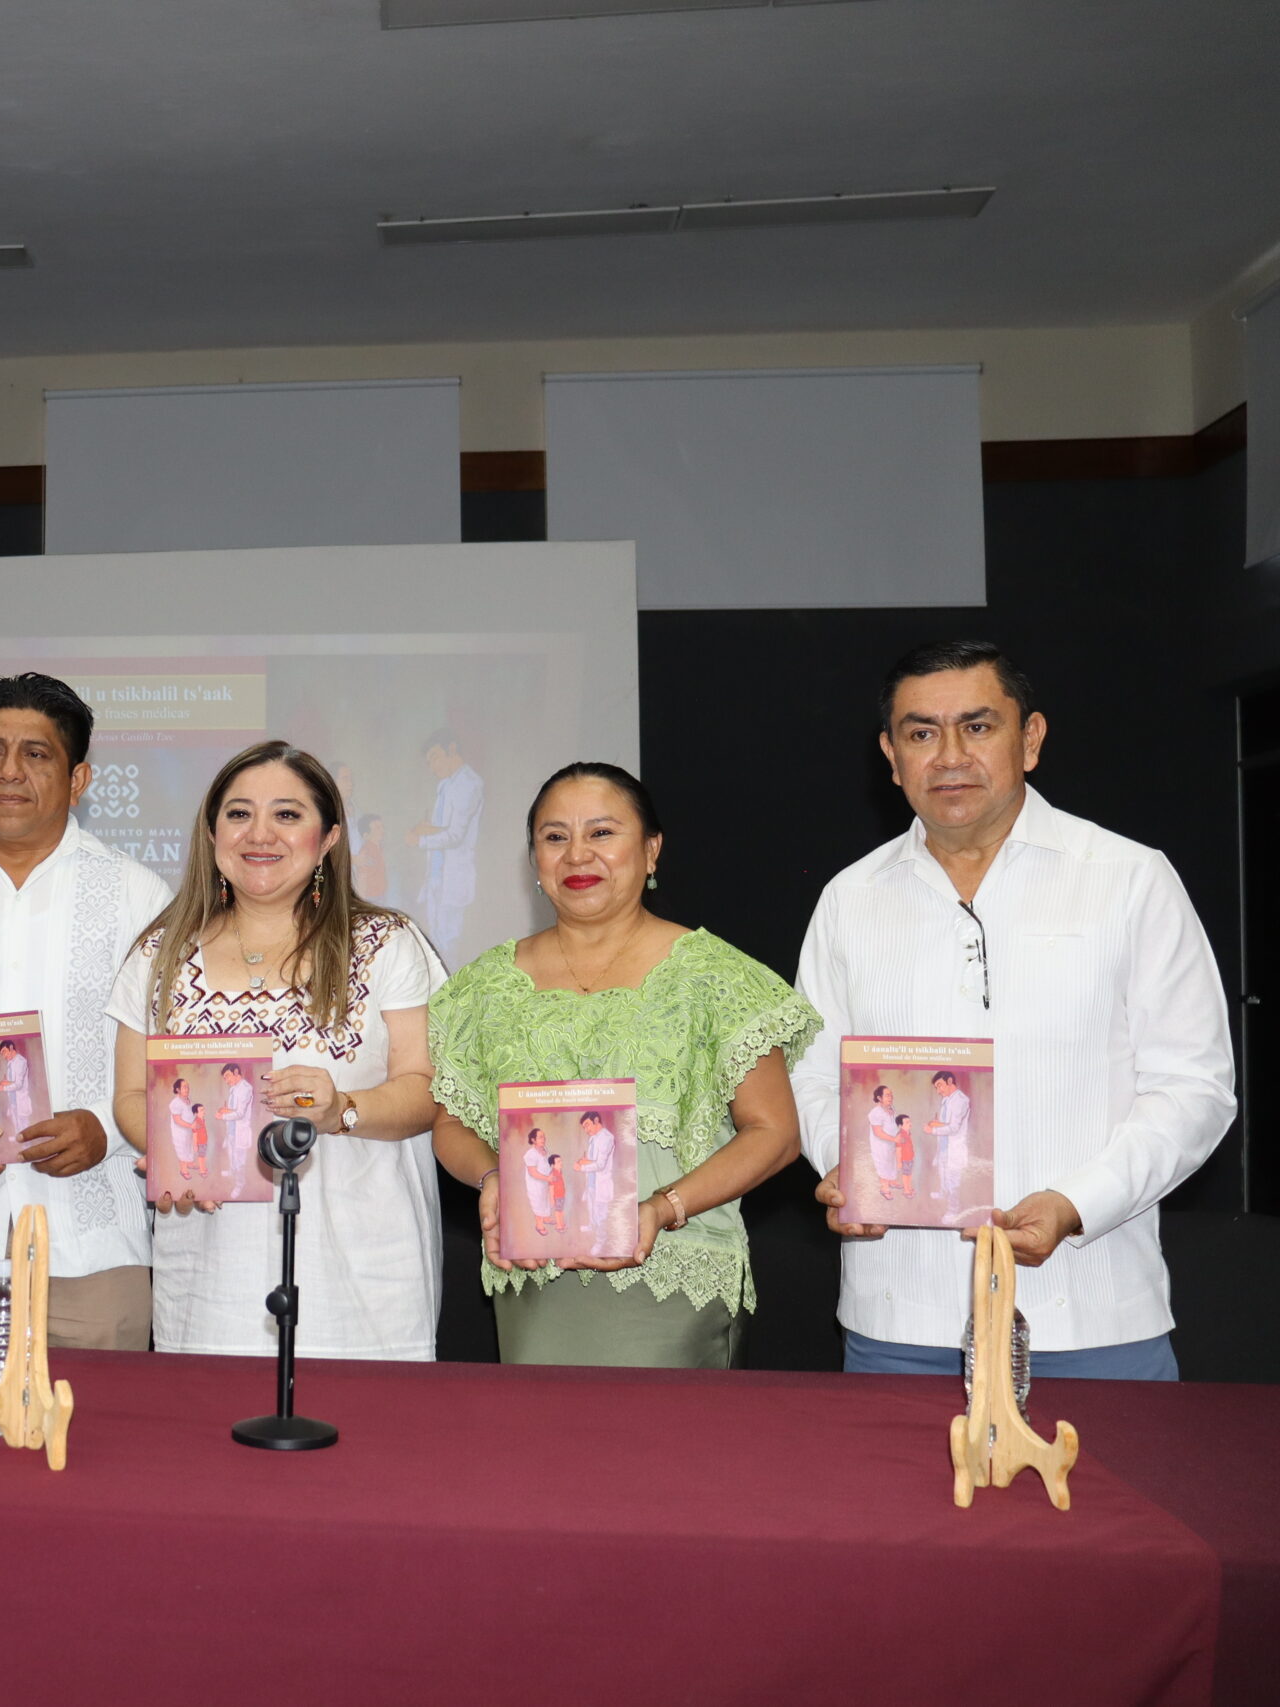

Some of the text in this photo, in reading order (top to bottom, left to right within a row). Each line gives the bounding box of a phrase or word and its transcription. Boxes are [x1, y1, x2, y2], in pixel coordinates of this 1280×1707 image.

[112, 686, 178, 701] tsikbalil
[105, 707, 138, 720] frases
[142, 706, 191, 718] médicas
[149, 828, 181, 837] MAYA
